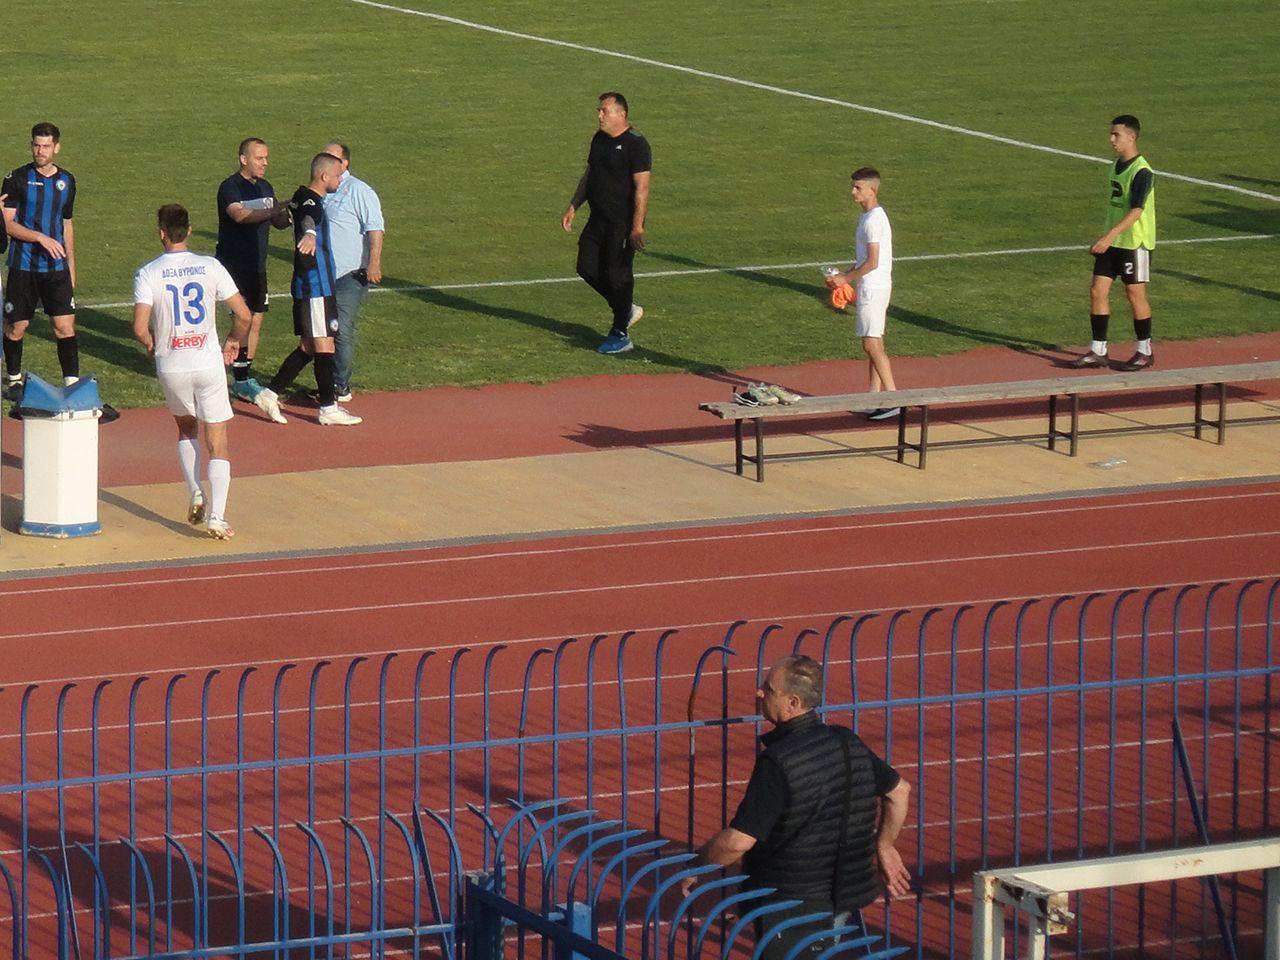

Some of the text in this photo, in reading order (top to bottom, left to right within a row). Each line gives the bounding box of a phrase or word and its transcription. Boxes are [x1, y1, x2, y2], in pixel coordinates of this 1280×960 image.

[162, 268, 178, 278] ΔΟΞΑ
[1124, 262, 1134, 275] 2
[165, 281, 206, 326] 13
[171, 334, 207, 350] DERBY
